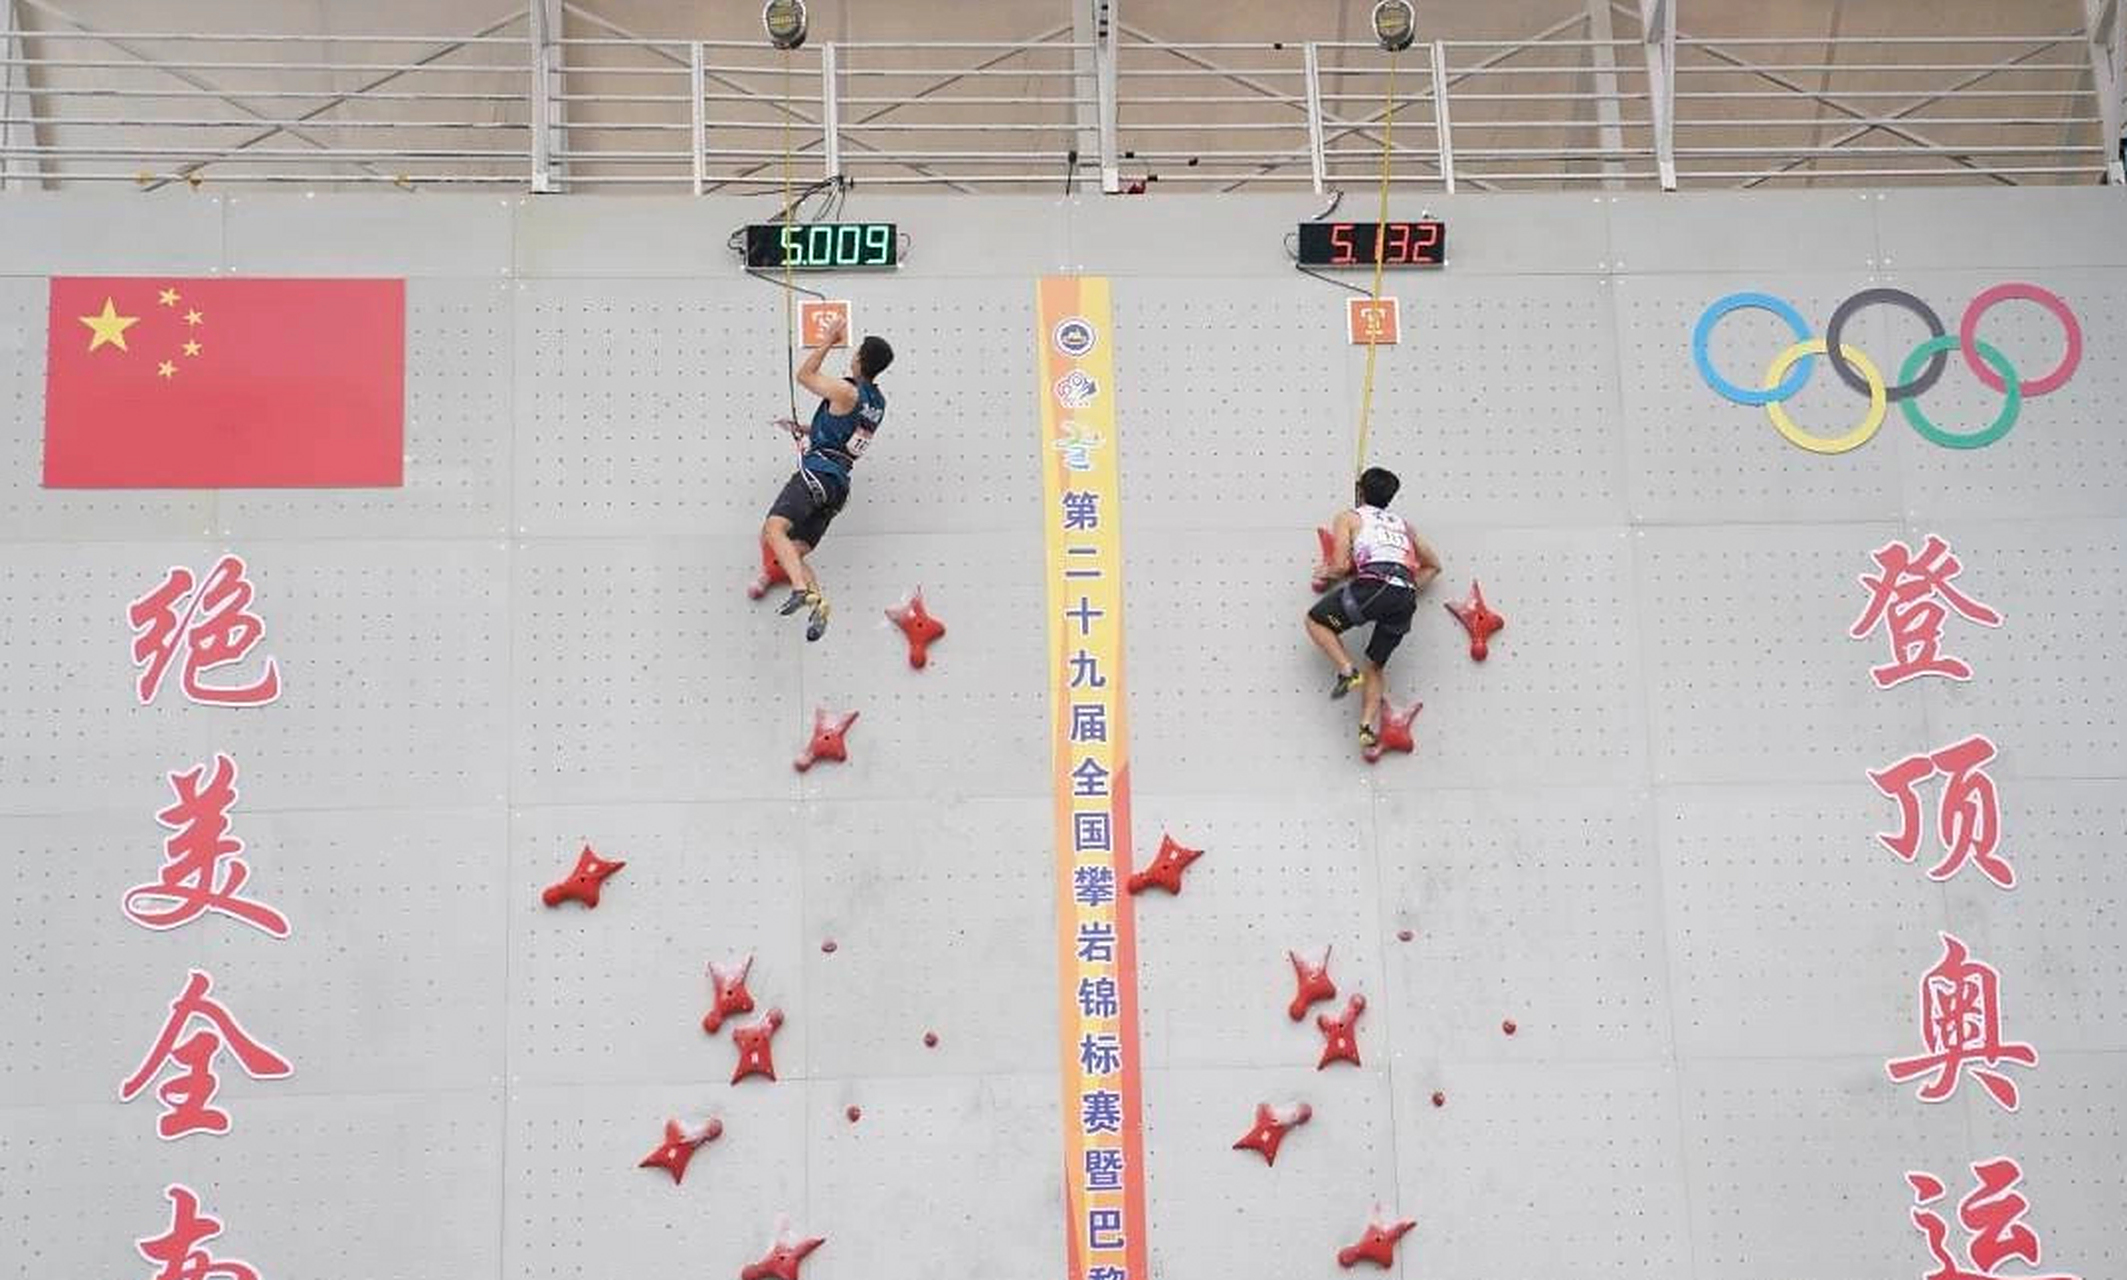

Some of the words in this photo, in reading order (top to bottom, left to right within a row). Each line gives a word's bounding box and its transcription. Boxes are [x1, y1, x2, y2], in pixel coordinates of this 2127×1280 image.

[780, 226, 890, 266] 5.009
[1331, 225, 1438, 263] 5.132
[1850, 534, 2081, 1280] 登顶奥运
